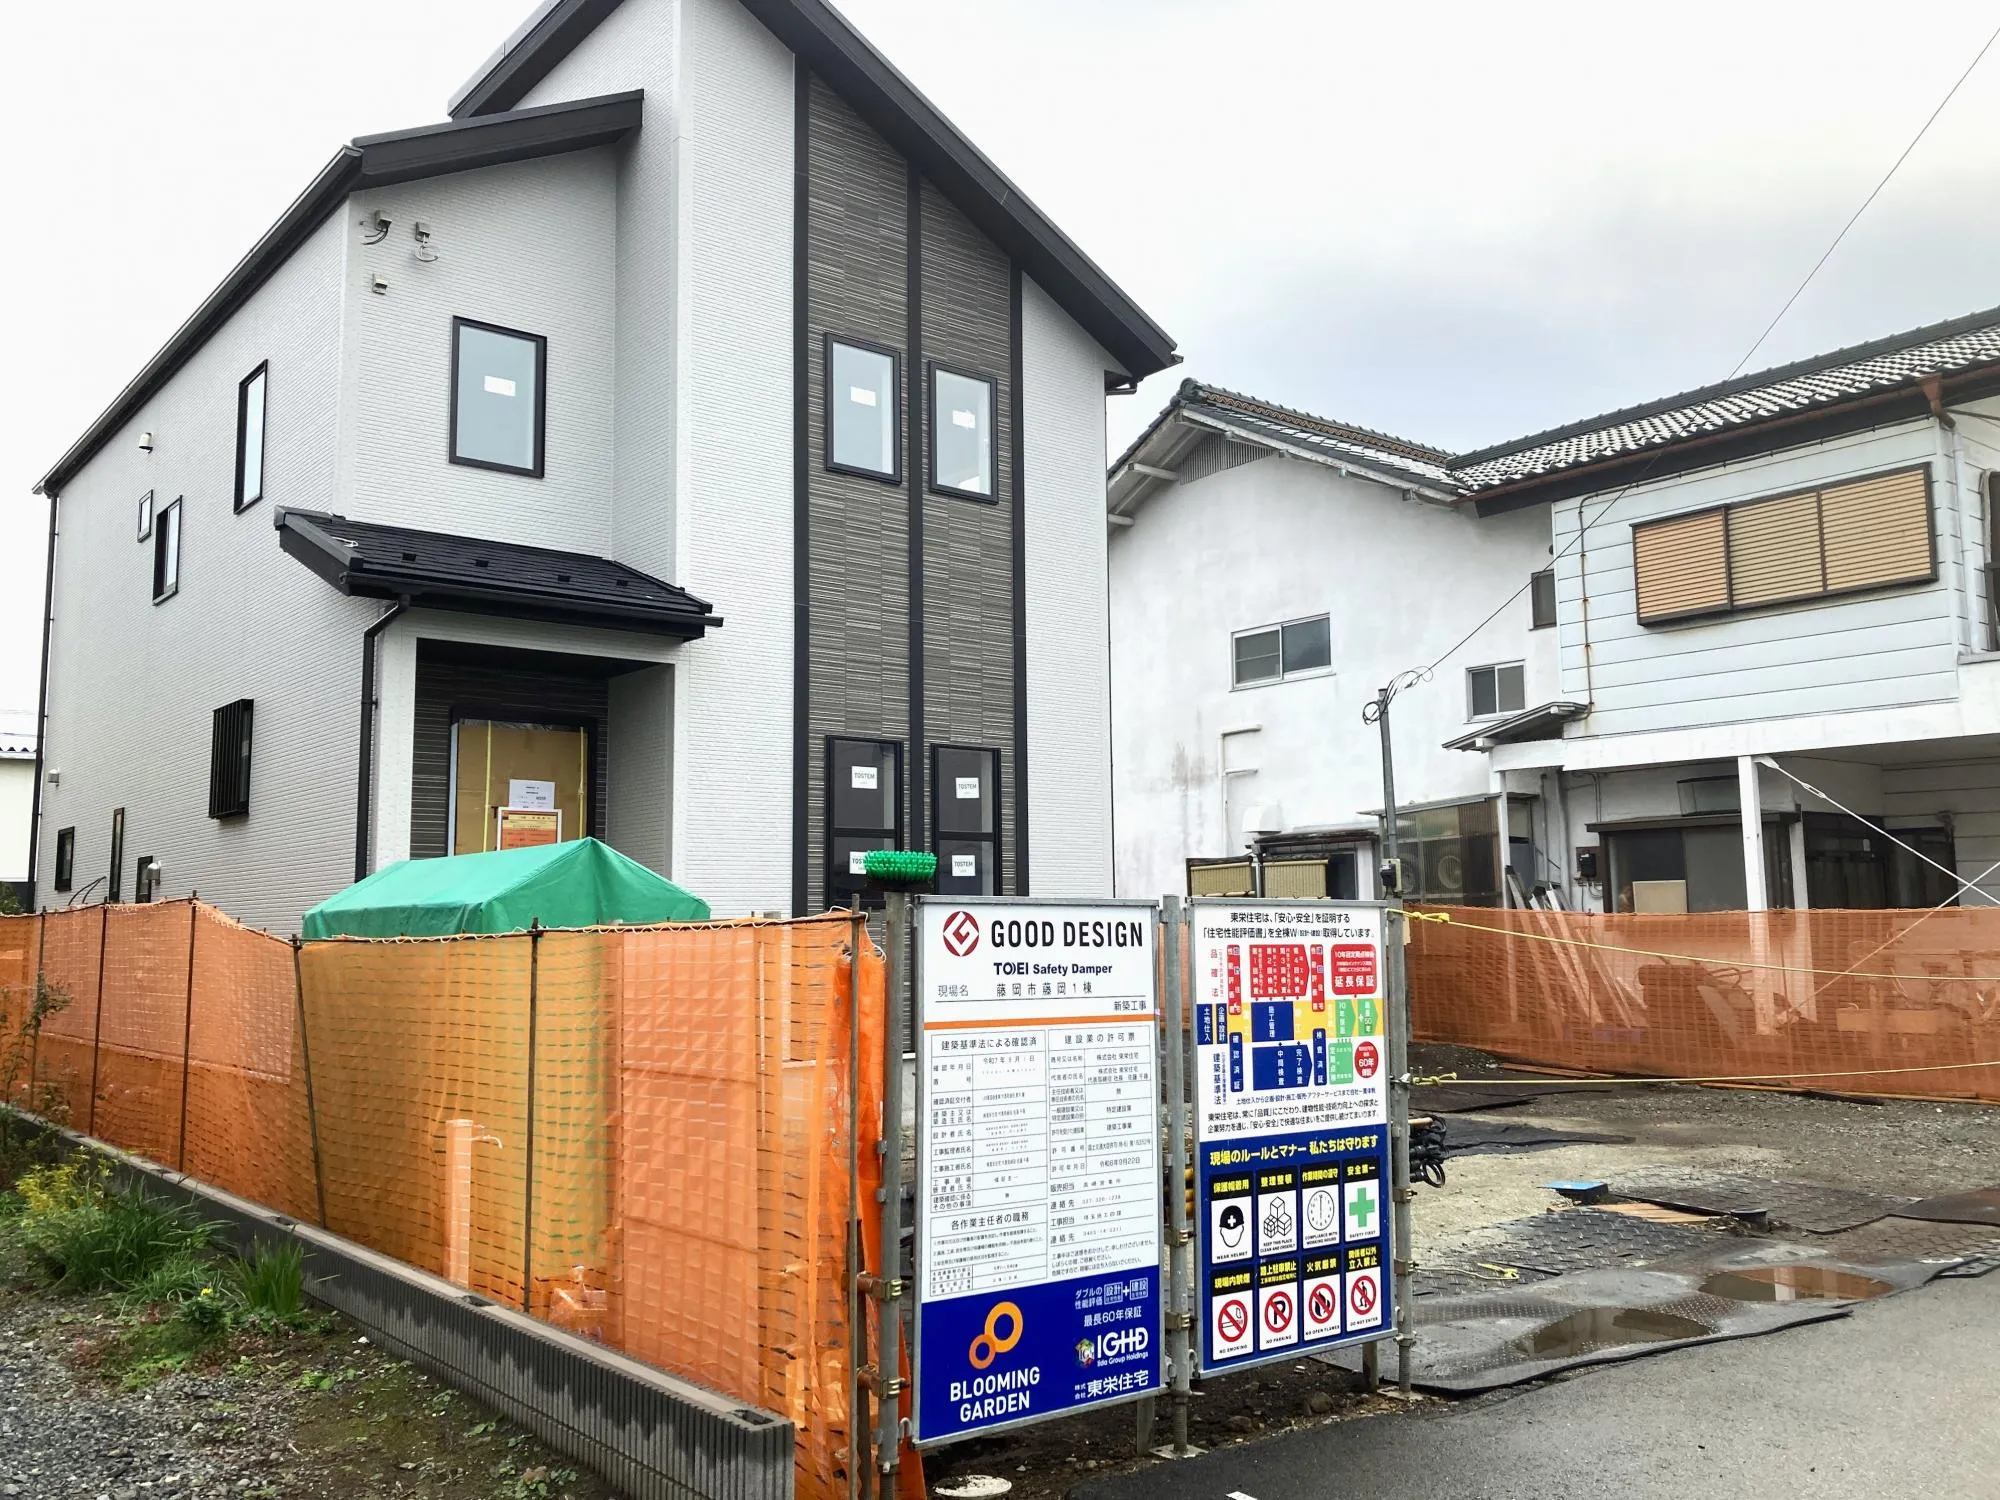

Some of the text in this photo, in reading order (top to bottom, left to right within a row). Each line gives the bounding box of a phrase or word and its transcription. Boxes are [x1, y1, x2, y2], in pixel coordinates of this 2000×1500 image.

[1230, 912, 1350, 923] 東栄住宅は、「安心・安全」を証明する
[991, 920, 1143, 948] GOOD DESIGN
[1033, 964, 1068, 976] Safety
[1072, 964, 1112, 976] Damper
[1335, 975, 1374, 988] 延長保証
[938, 982, 1092, 997] 現場名 藤岡市藤岡1棟
[1114, 1001, 1147, 1011] 新築工事
[942, 1036, 1036, 1050] 建築基準法による確認済
[1065, 1032, 1134, 1044] 建設業の許可票
[933, 1063, 971, 1072] 確認年月日
[1359, 1058, 1374, 1067] 60年
[933, 1096, 971, 1105] 確認済証交付者
[1107, 1122, 1132, 1130] 建築工事業
[933, 1129, 971, 1138] 設計者氏名
[934, 1146, 971, 1156] 工事監理者氏名
[1210, 1134, 1378, 1166] 現場のルールとマナー 私たちは守ります
[1302, 1168, 1338, 1182] 作業時間の遵守
[1347, 1164, 1376, 1176] 安全第一
[1050, 1182, 1074, 1192] 販売担当
[1214, 1179, 1249, 1193] 保護帽着用
[1261, 1174, 1292, 1187] 整理整頓
[933, 1200, 971, 1210] その他の事項
[1051, 1200, 1074, 1209] 連絡先
[952, 1211, 1029, 1231] 各作業主任者の職務
[1051, 1216, 1074, 1226] 工事担当
[1050, 1233, 1074, 1244] 連絡先
[1348, 1246, 1377, 1259] 関係者以外
[1260, 1261, 1296, 1276] 路上駐車禁止
[1306, 1258, 1336, 1273] 火気厳禁
[1348, 1256, 1377, 1269] 立入禁止
[1131, 1280, 1147, 1292] 建設
[1214, 1273, 1250, 1288] 現場内禁煙
[1076, 1287, 1102, 1299] ダブルの
[1106, 1285, 1121, 1296] 設計
[1075, 1296, 1102, 1310] 性能評価
[1084, 1306, 1141, 1327] 最長60年保証
[1097, 1327, 1148, 1358] IGHD
[1227, 1344, 1248, 1353] SMOKING
[1108, 1356, 1125, 1365] Group
[1126, 1352, 1148, 1360] Holdings
[951, 1366, 1040, 1402] BLOOMING
[1087, 1370, 1148, 1398] 東栄住宅
[960, 1390, 1030, 1422] GARDEN
